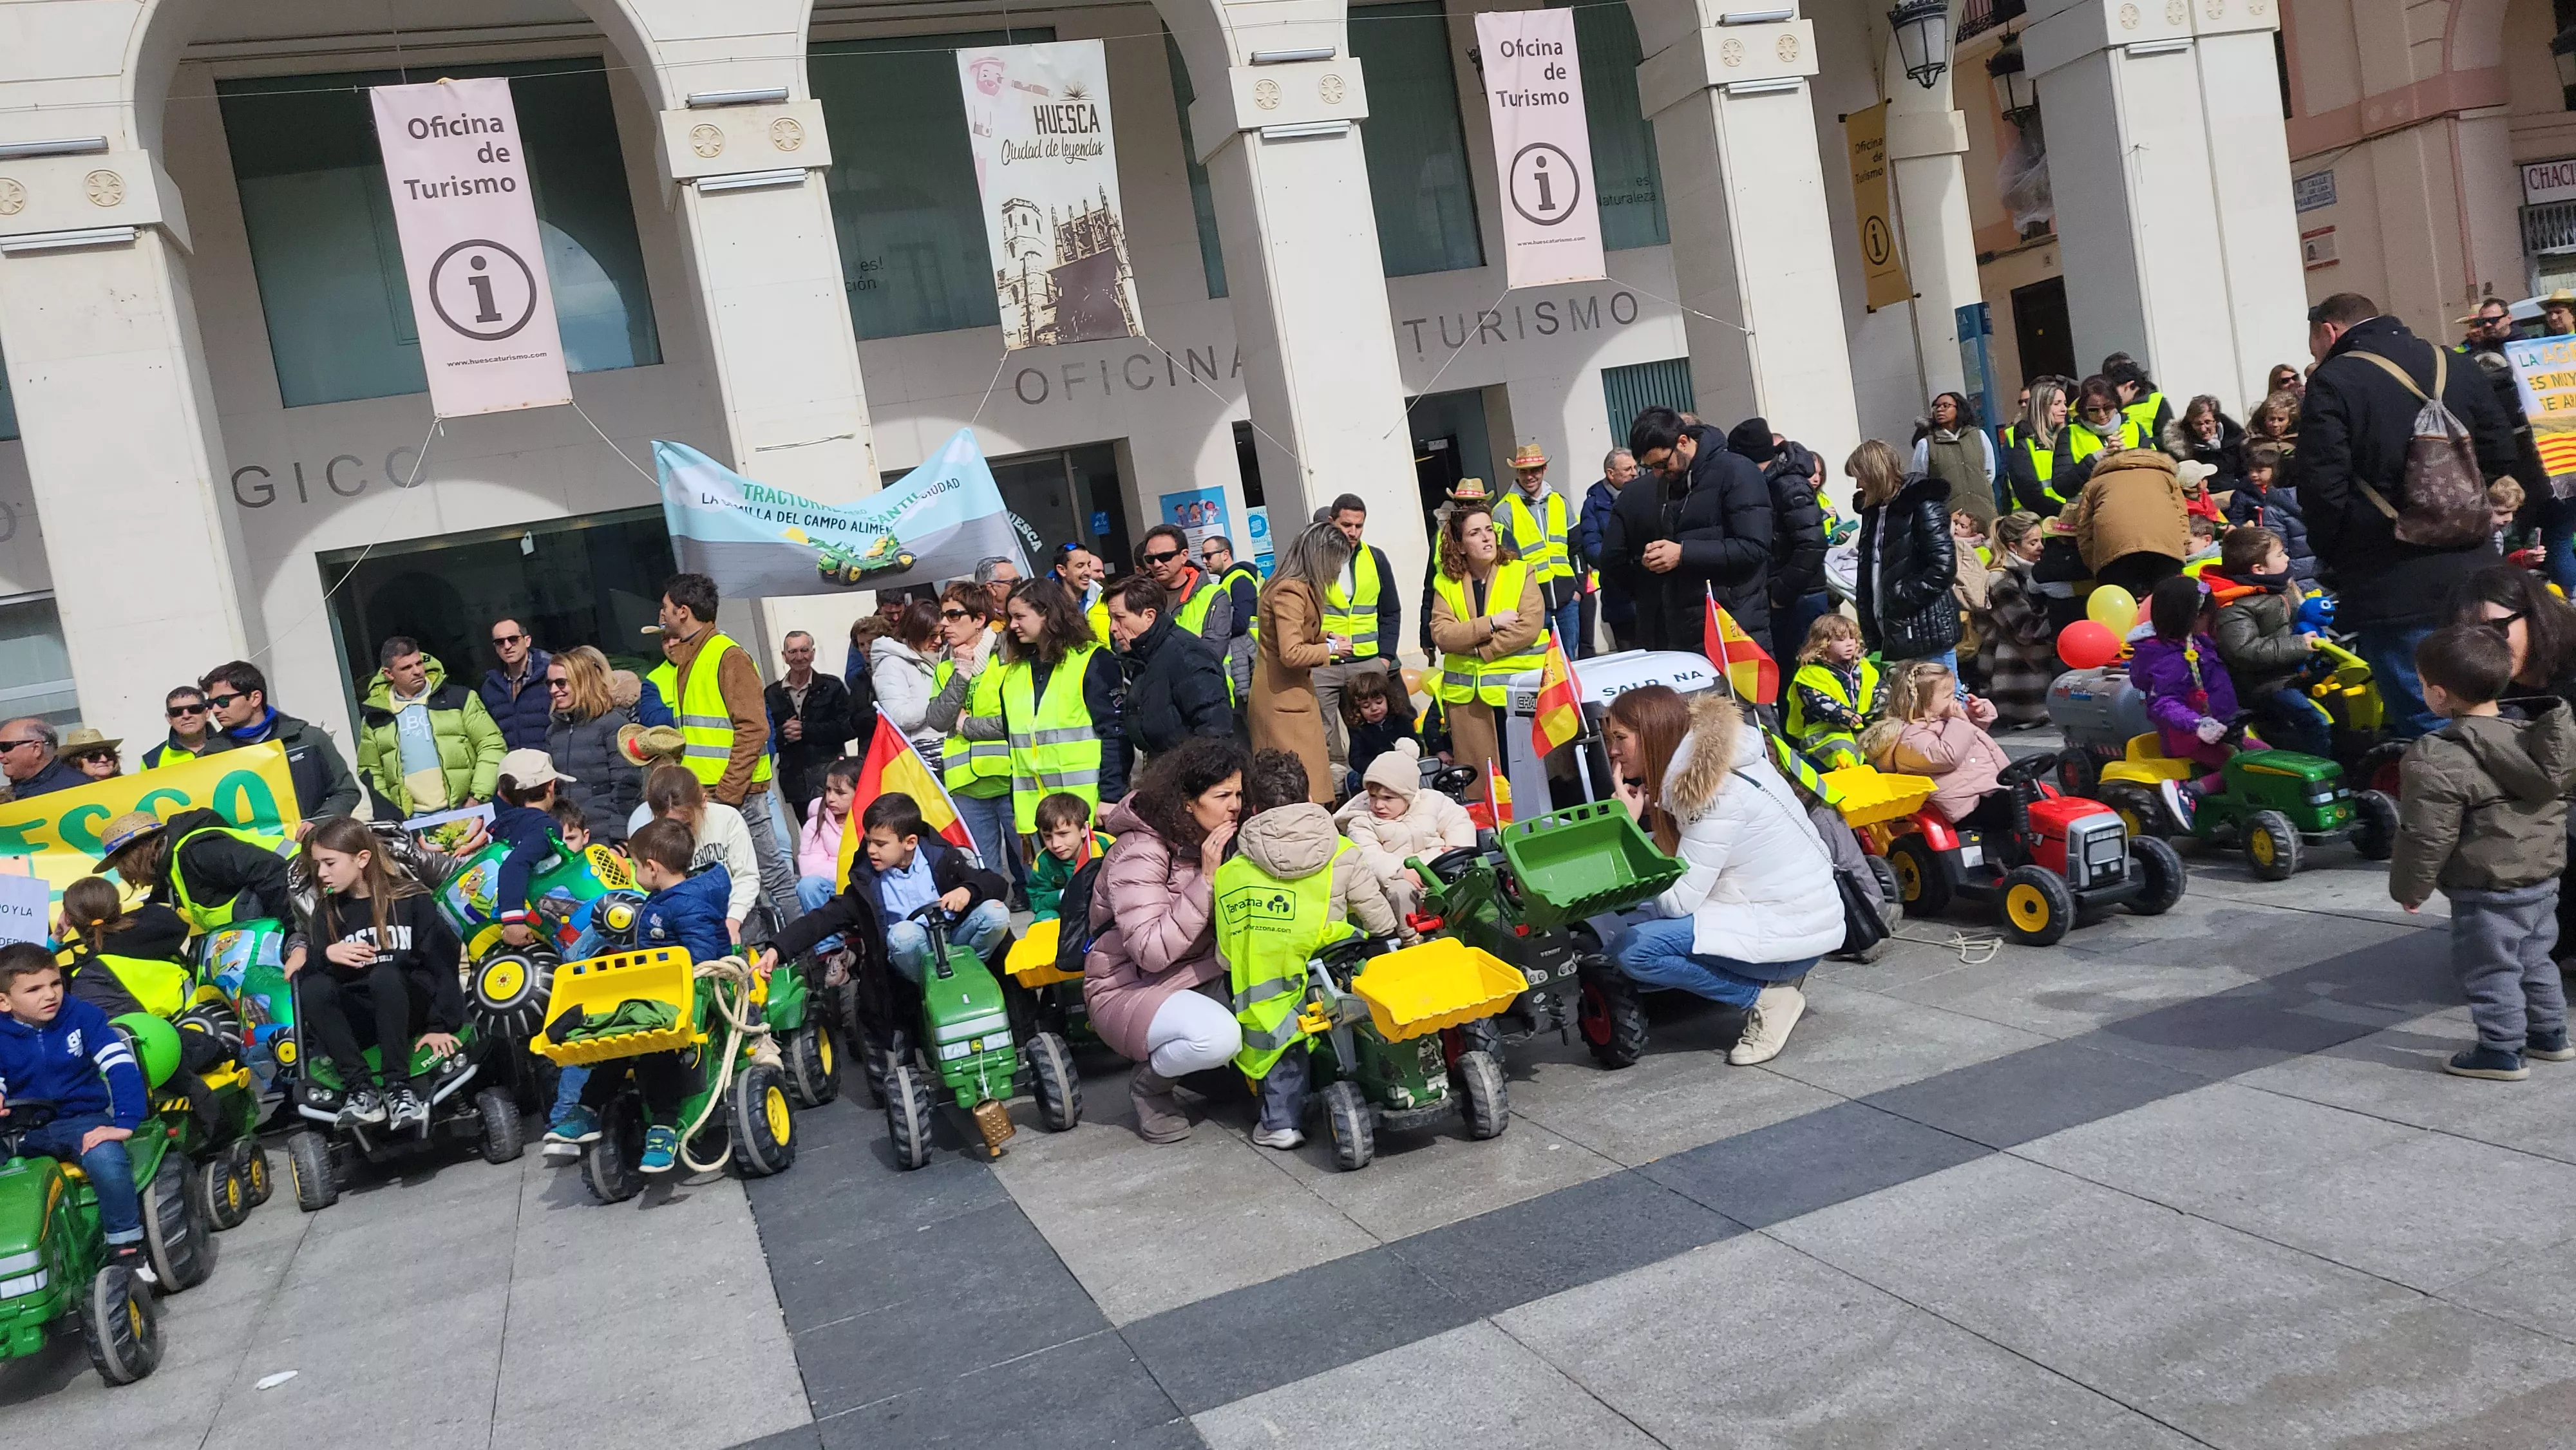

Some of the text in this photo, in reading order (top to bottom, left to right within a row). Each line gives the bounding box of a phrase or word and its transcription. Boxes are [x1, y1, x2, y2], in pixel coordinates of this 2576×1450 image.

[1500, 38, 1563, 58] Oficina
[1544, 62, 1567, 80] de
[1495, 88, 1569, 108] Turismo
[408, 113, 505, 140] Oficina
[1033, 104, 1101, 135] HUESCA
[477, 140, 511, 164] de
[1001, 137, 1105, 165] Ciudad de leyendas
[1855, 136, 1884, 154] Oficina
[1873, 151, 1884, 163] de
[404, 174, 516, 200] Turismo
[860, 256, 884, 272] es!
[1402, 290, 1638, 353] TURISMO
[446, 351, 547, 368] www.huescaturismo.com
[2518, 353, 2541, 368] LA
[701, 492, 719, 505] LA
[777, 511, 799, 525] DEL
[804, 514, 846, 531] CAMPO
[12, 905, 19, 915] Y
[20, 907, 33, 918] LA
